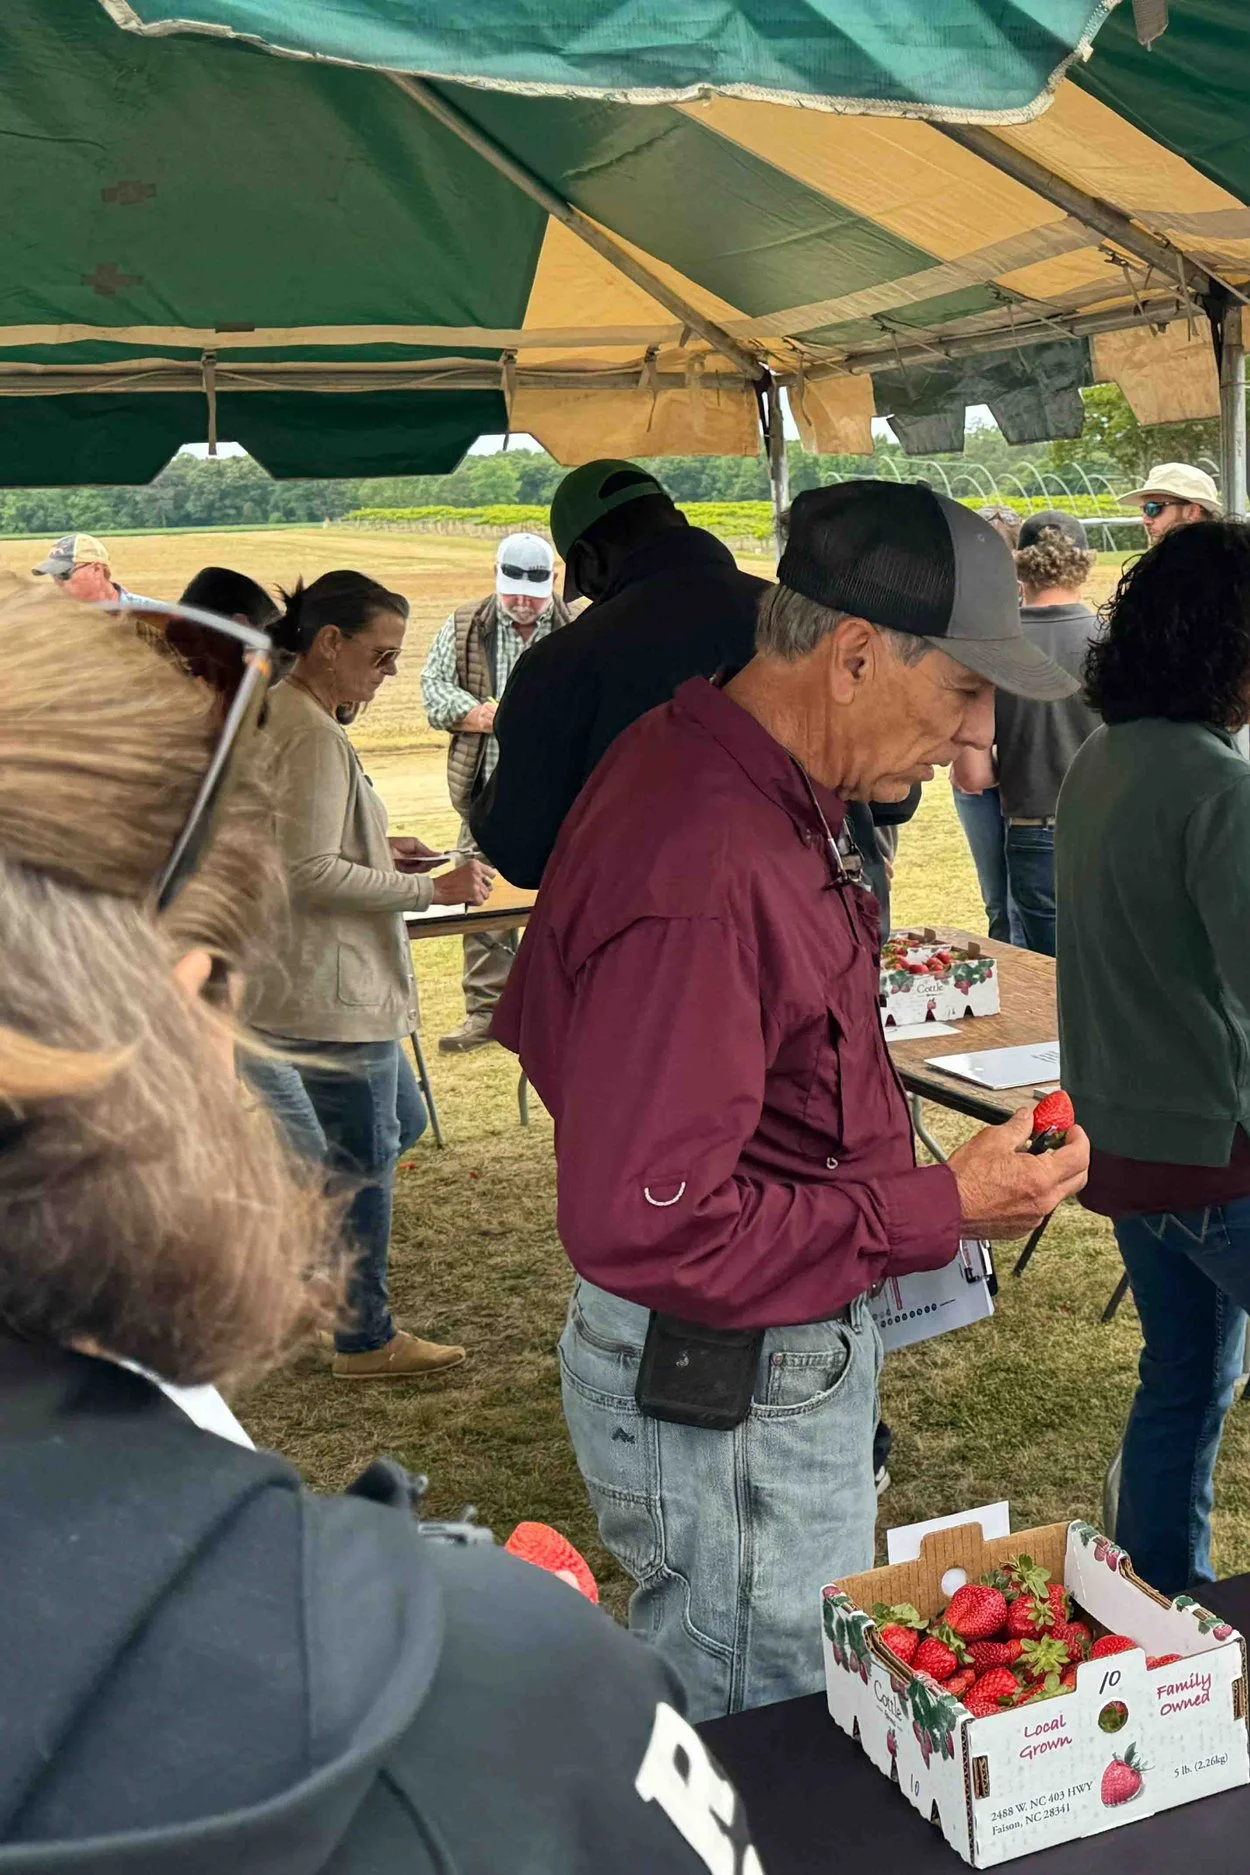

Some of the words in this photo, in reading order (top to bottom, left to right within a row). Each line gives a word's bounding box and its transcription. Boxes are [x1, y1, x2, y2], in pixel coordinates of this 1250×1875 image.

[917, 983, 943, 993] Cottle
[1099, 1670, 1121, 1695] 10
[1157, 1672, 1212, 1699] Family
[1160, 1689, 1211, 1716] Owned
[1024, 1714, 1067, 1738] Local
[1019, 1735, 1073, 1760] Grown
[1174, 1768, 1180, 1778] 5
[1181, 1765, 1193, 1776] lb.
[1194, 1753, 1229, 1772] (2.26kg)
[910, 1773, 920, 1797] 10
[991, 1806, 1014, 1822] 2488
[1017, 1802, 1027, 1815] W.
[1030, 1796, 1047, 1811] NC
[1048, 1792, 1065, 1805] 403
[1067, 1781, 1094, 1798] HWY
[992, 1820, 1023, 1836] Faison,
[1025, 1812, 1042, 1826] NC
[1043, 1802, 1071, 1820] 28341
